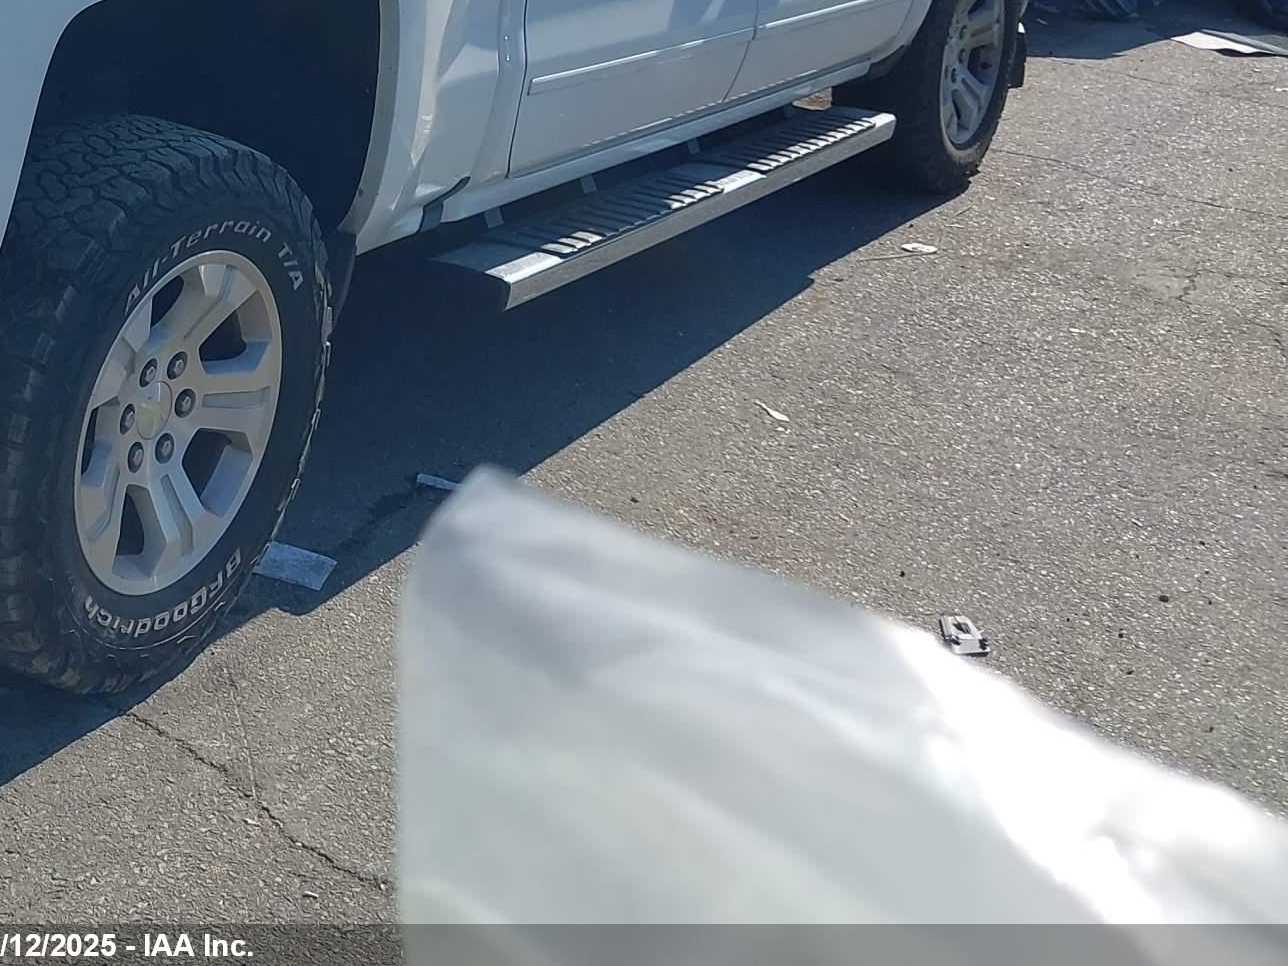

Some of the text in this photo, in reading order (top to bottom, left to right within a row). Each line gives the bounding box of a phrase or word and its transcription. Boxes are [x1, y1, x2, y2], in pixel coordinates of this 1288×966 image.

[124, 218, 304, 315] All-Terrain T/A
[84, 546, 242, 638] BFGoodrich
